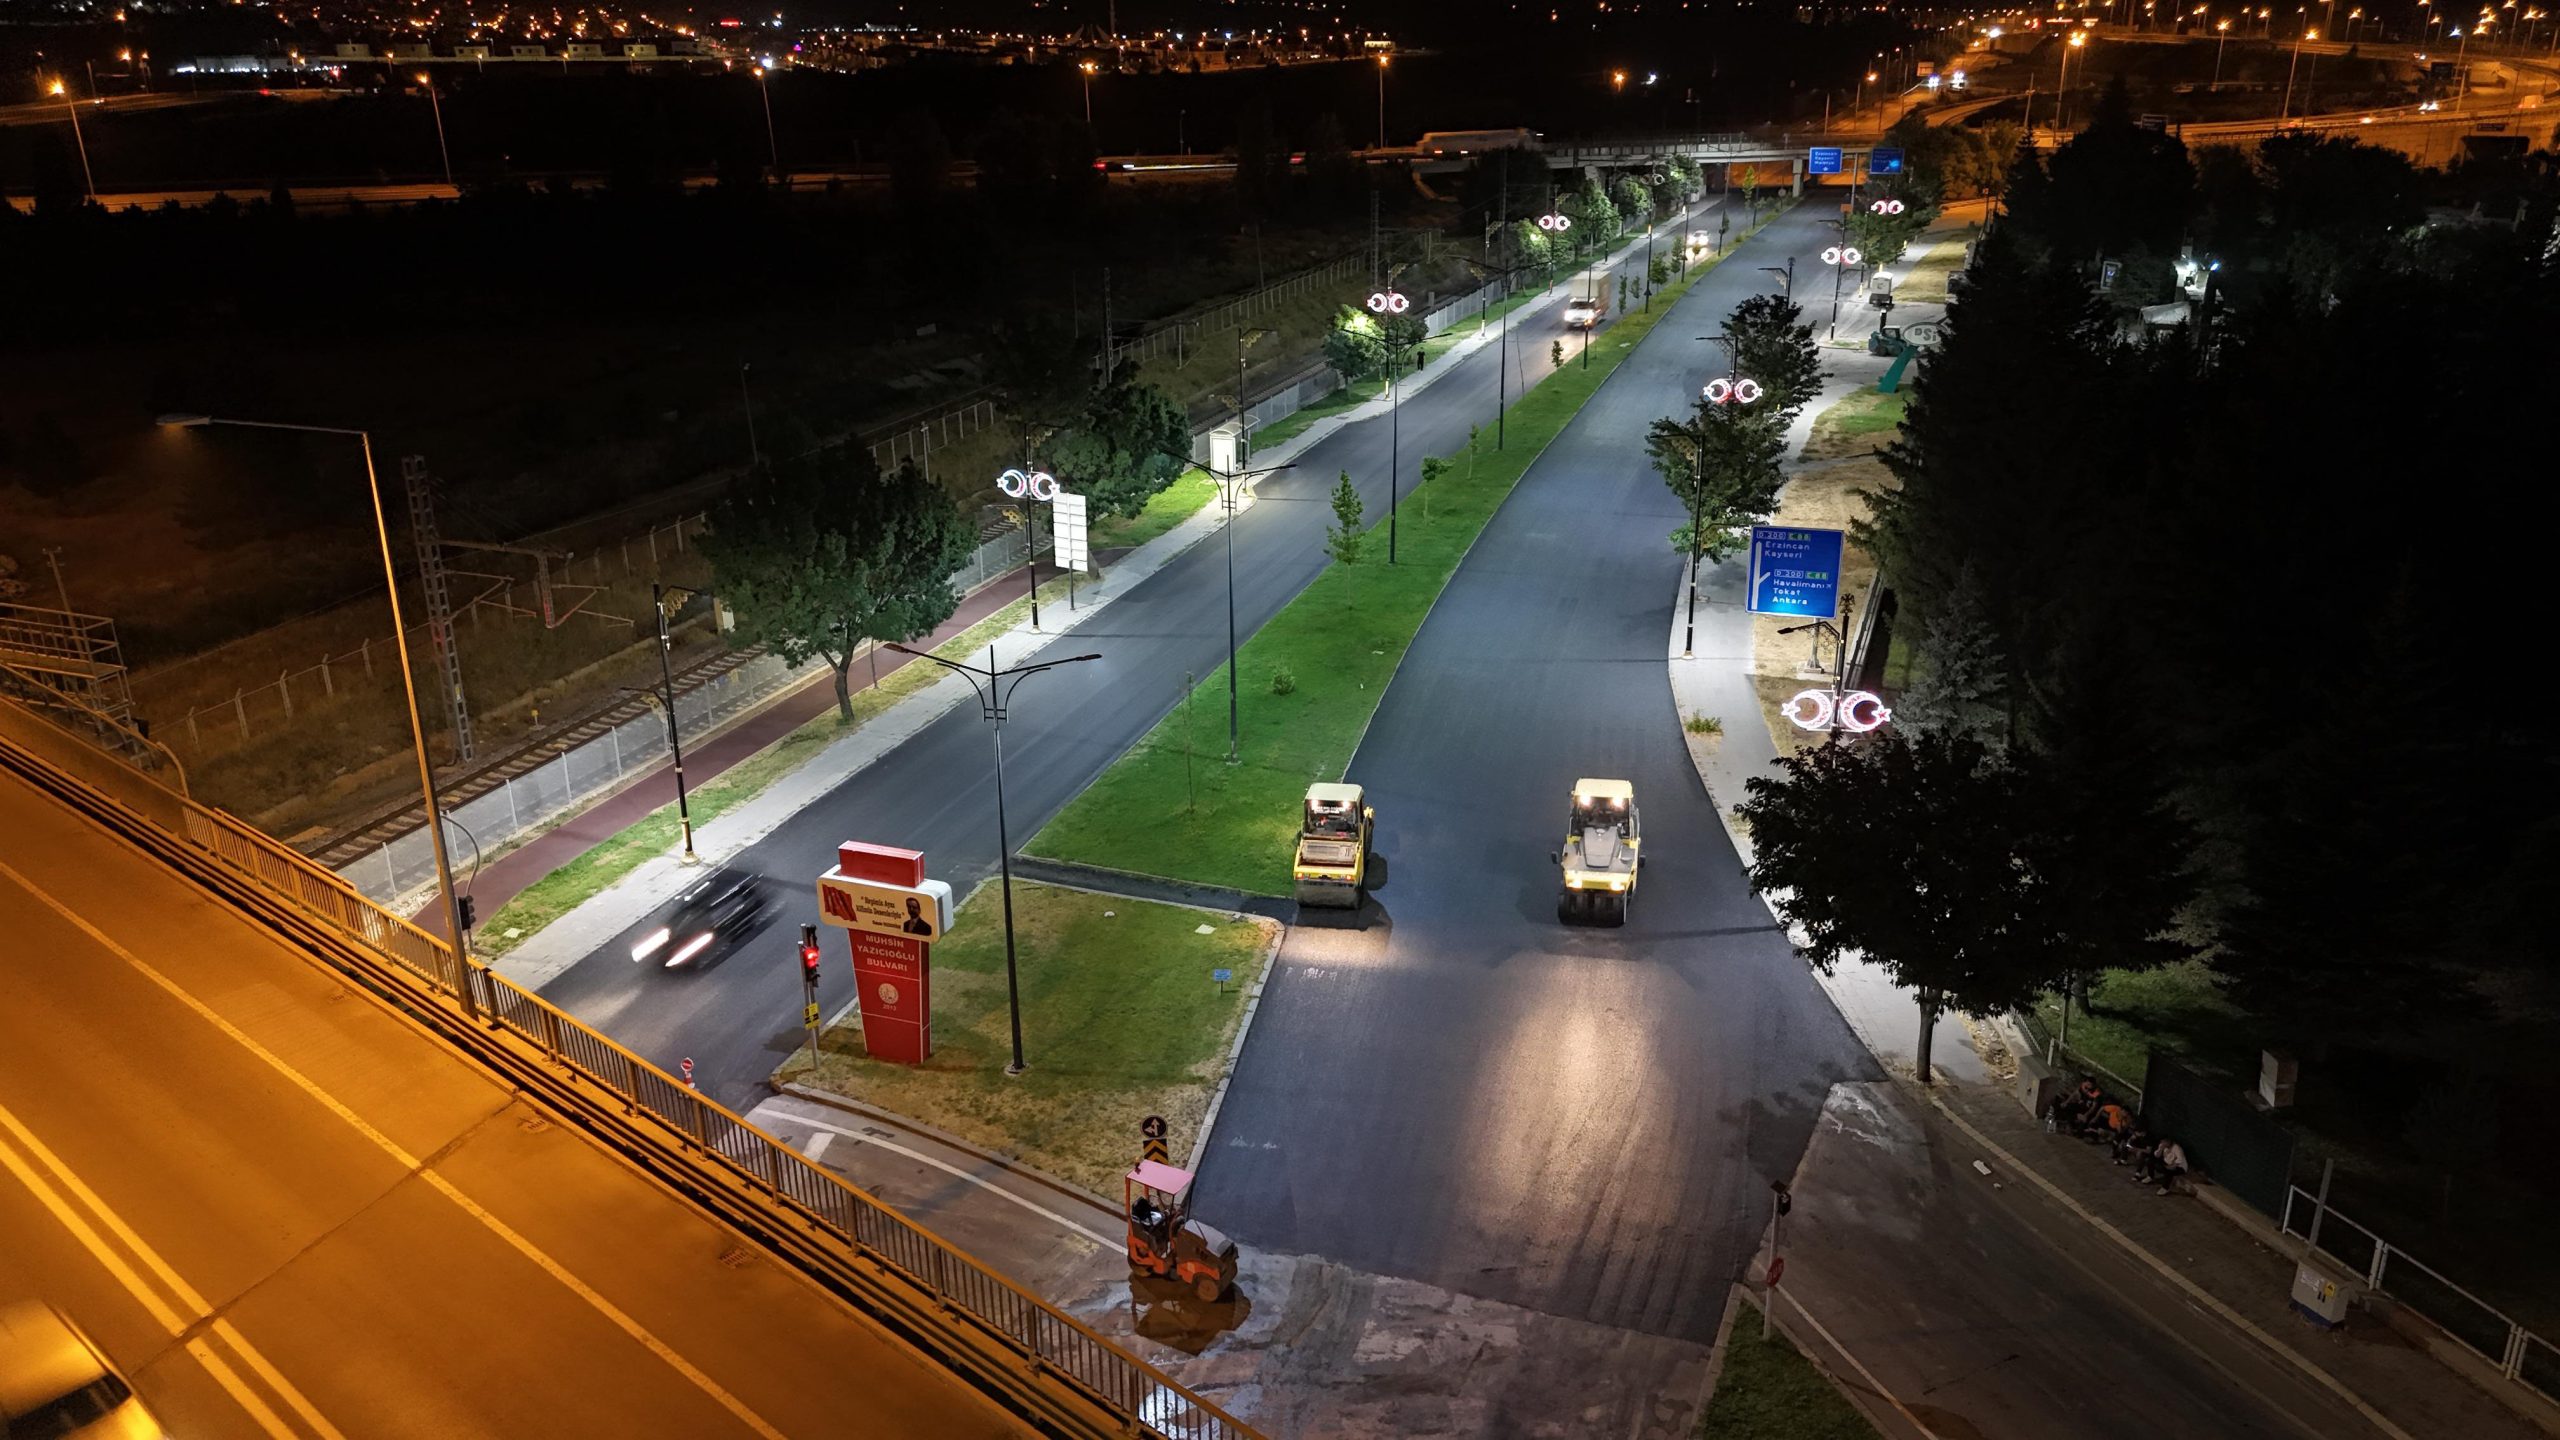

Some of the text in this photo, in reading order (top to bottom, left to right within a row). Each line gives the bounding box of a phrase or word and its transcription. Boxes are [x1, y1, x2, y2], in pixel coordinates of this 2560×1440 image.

[1765, 541, 1810, 550] Erzincan
[1764, 550, 1802, 558] Kayseri
[1773, 587, 1801, 595] Tokat
[1772, 596, 1808, 605] Ankara
[865, 935, 904, 948] MUHSİN
[856, 944, 915, 961] YAZICIOĞLU
[866, 958, 908, 972] BULVARI
